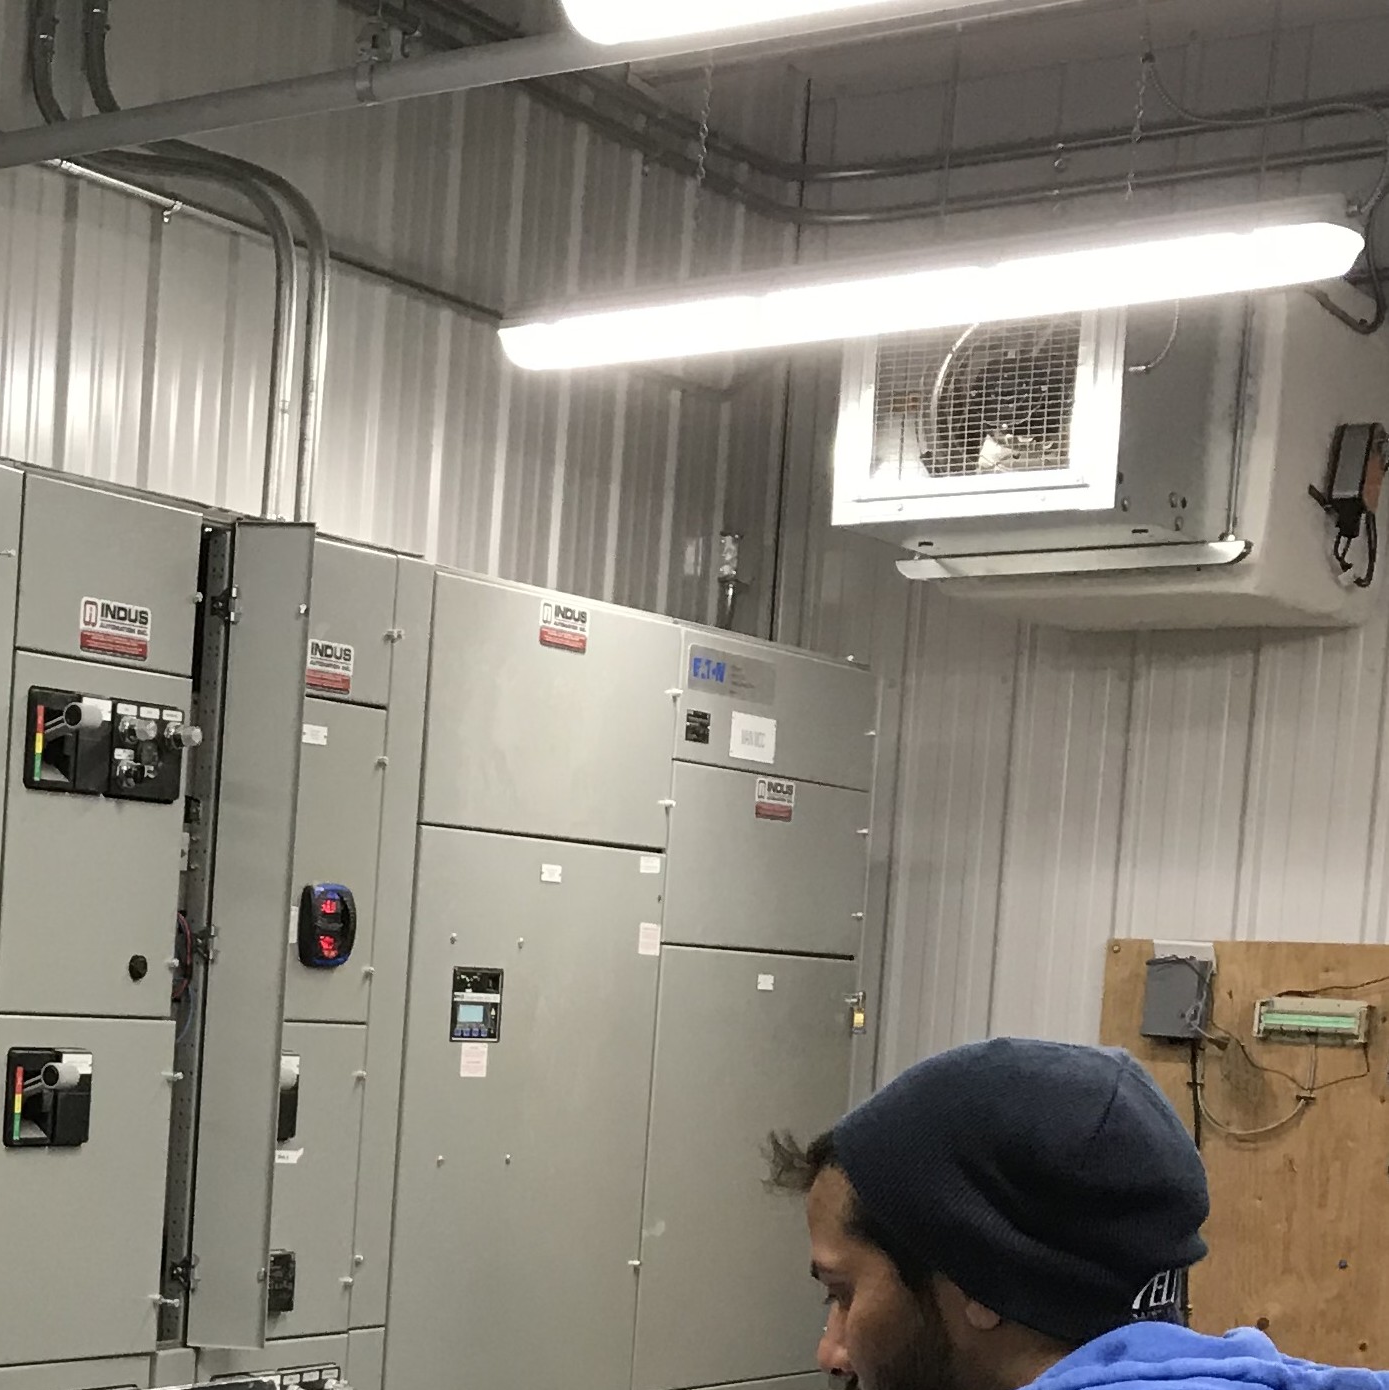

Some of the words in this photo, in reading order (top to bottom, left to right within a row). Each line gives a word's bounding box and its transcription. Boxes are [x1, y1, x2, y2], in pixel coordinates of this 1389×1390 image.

[100, 602, 150, 626] INDUS
[554, 604, 587, 624] INDUS
[311, 641, 352, 662] INDUS
[766, 781, 794, 796] INDUS
